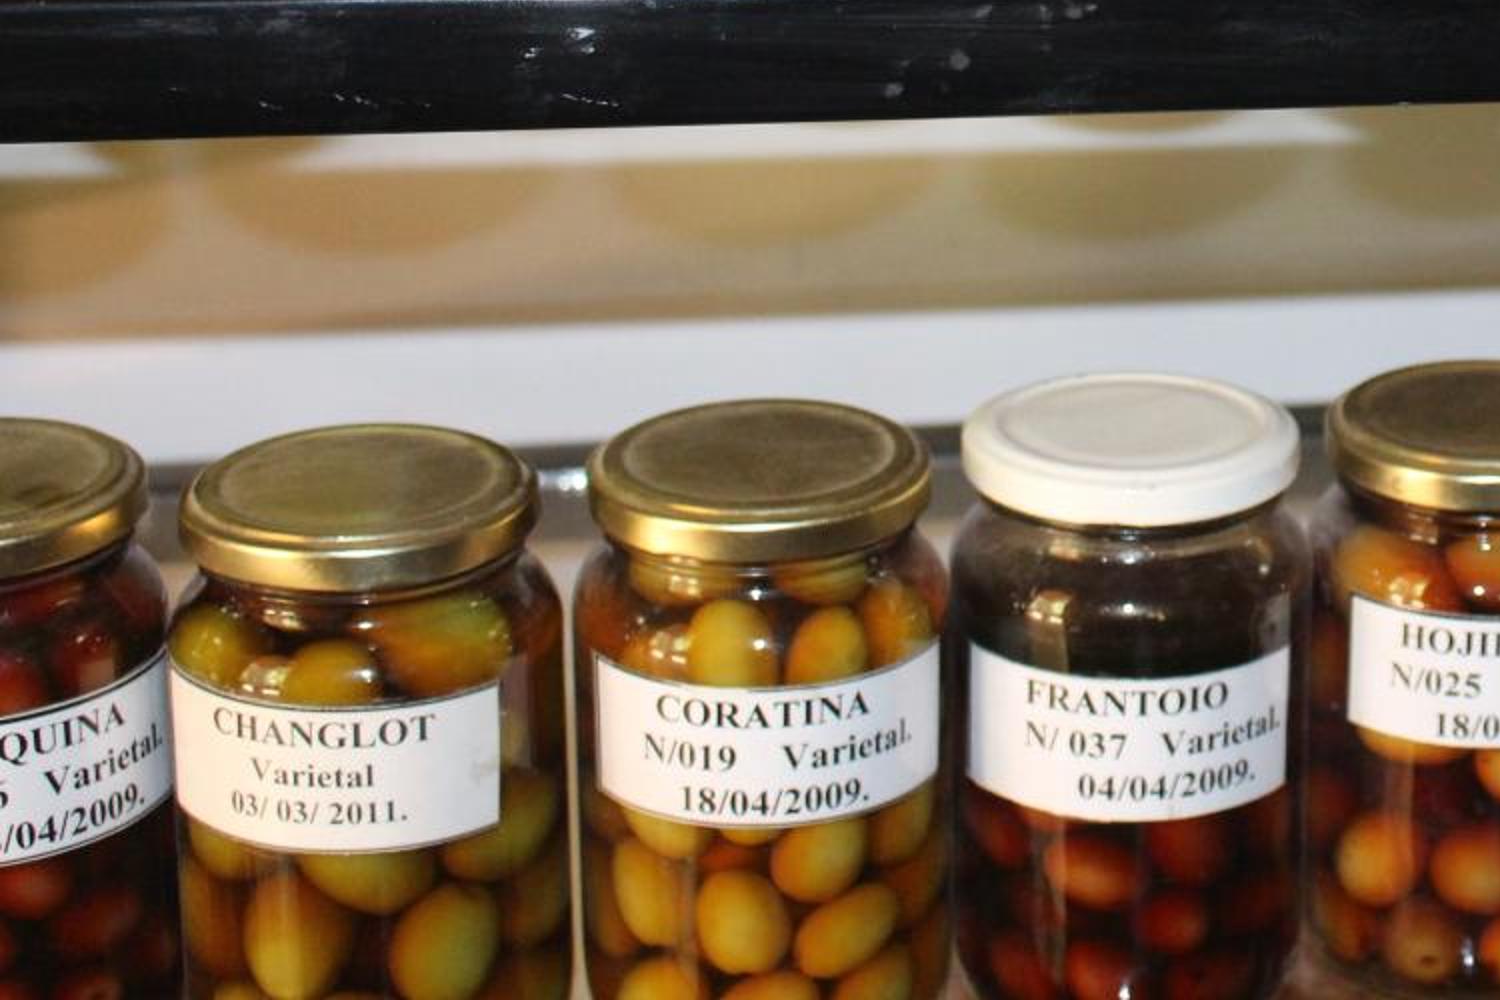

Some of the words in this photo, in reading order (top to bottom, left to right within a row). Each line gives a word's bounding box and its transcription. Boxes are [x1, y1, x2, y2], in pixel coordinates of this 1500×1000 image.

[1026, 680, 1230, 718] FRANTOIO
[1390, 661, 1482, 699] N/025
[212, 706, 437, 750] CHANGLOT
[655, 690, 870, 730] CORATINA
[643, 732, 737, 771] N/019
[783, 716, 913, 770] Varietal.
[1068, 731, 1128, 760] 037
[1161, 704, 1281, 758] Varietal.
[43, 722, 163, 796] Varietal.
[249, 756, 375, 789] Varietal
[1078, 758, 1256, 802] 04/04/2009.
[0, 782, 145, 853] /04/2009.
[329, 799, 408, 826] 2011.
[681, 777, 871, 817] 18/04/2009.
